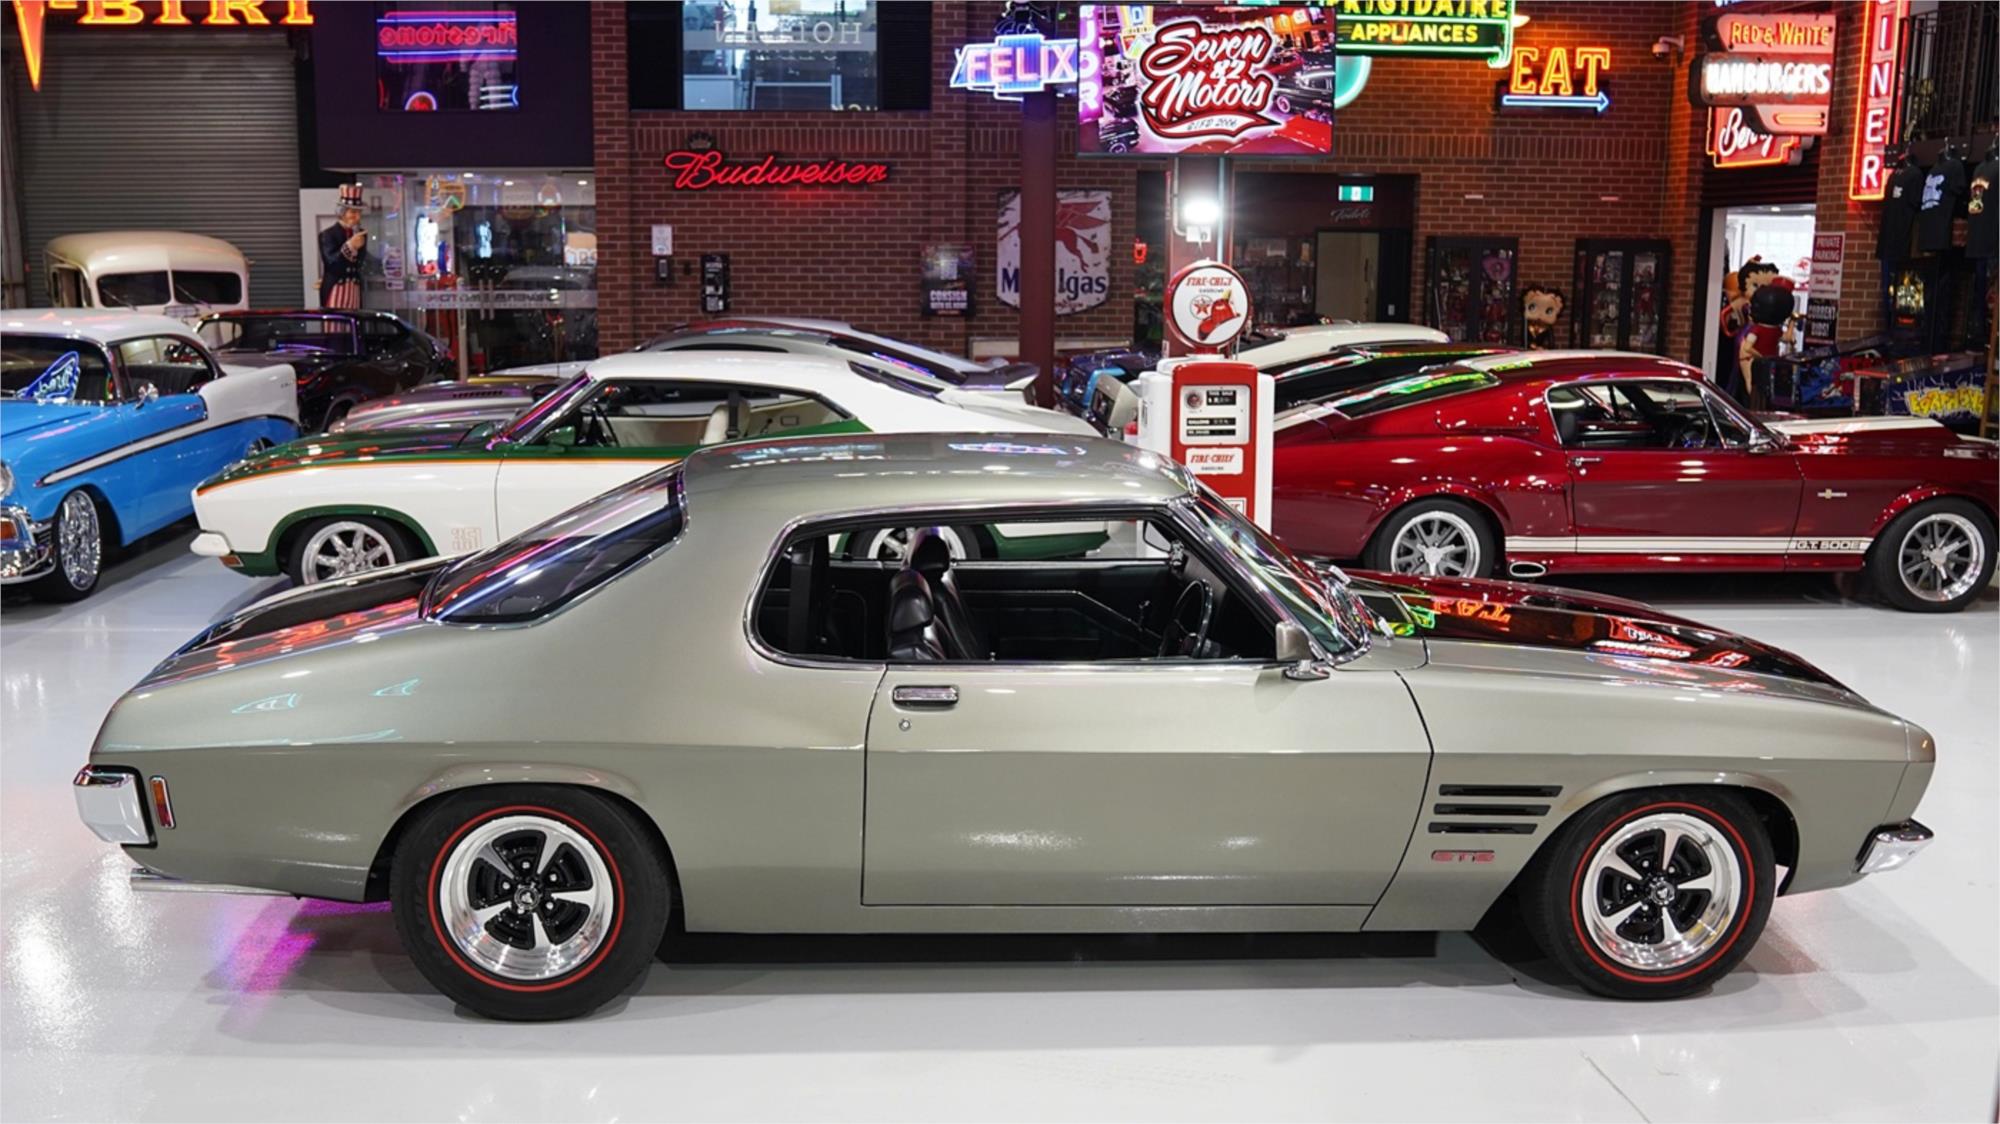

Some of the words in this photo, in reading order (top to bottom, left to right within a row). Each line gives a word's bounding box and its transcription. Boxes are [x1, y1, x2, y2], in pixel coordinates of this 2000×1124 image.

[1146, 22, 1265, 76] Seven
[1351, 24, 1478, 42] APPLIANCES
[1732, 22, 1760, 43] RED
[1763, 26, 1775, 46] &
[1778, 22, 1829, 45] WHITE
[967, 46, 1074, 82] FELIX
[1210, 59, 1246, 79] 82
[1511, 47, 1610, 95] EAT
[1706, 62, 1831, 94] HAMBURGERS
[1147, 72, 1267, 120] Motors
[1861, 0, 1891, 189] INER
[665, 151, 887, 188] Budweiser
[1001, 267, 1107, 301] Mlgas
